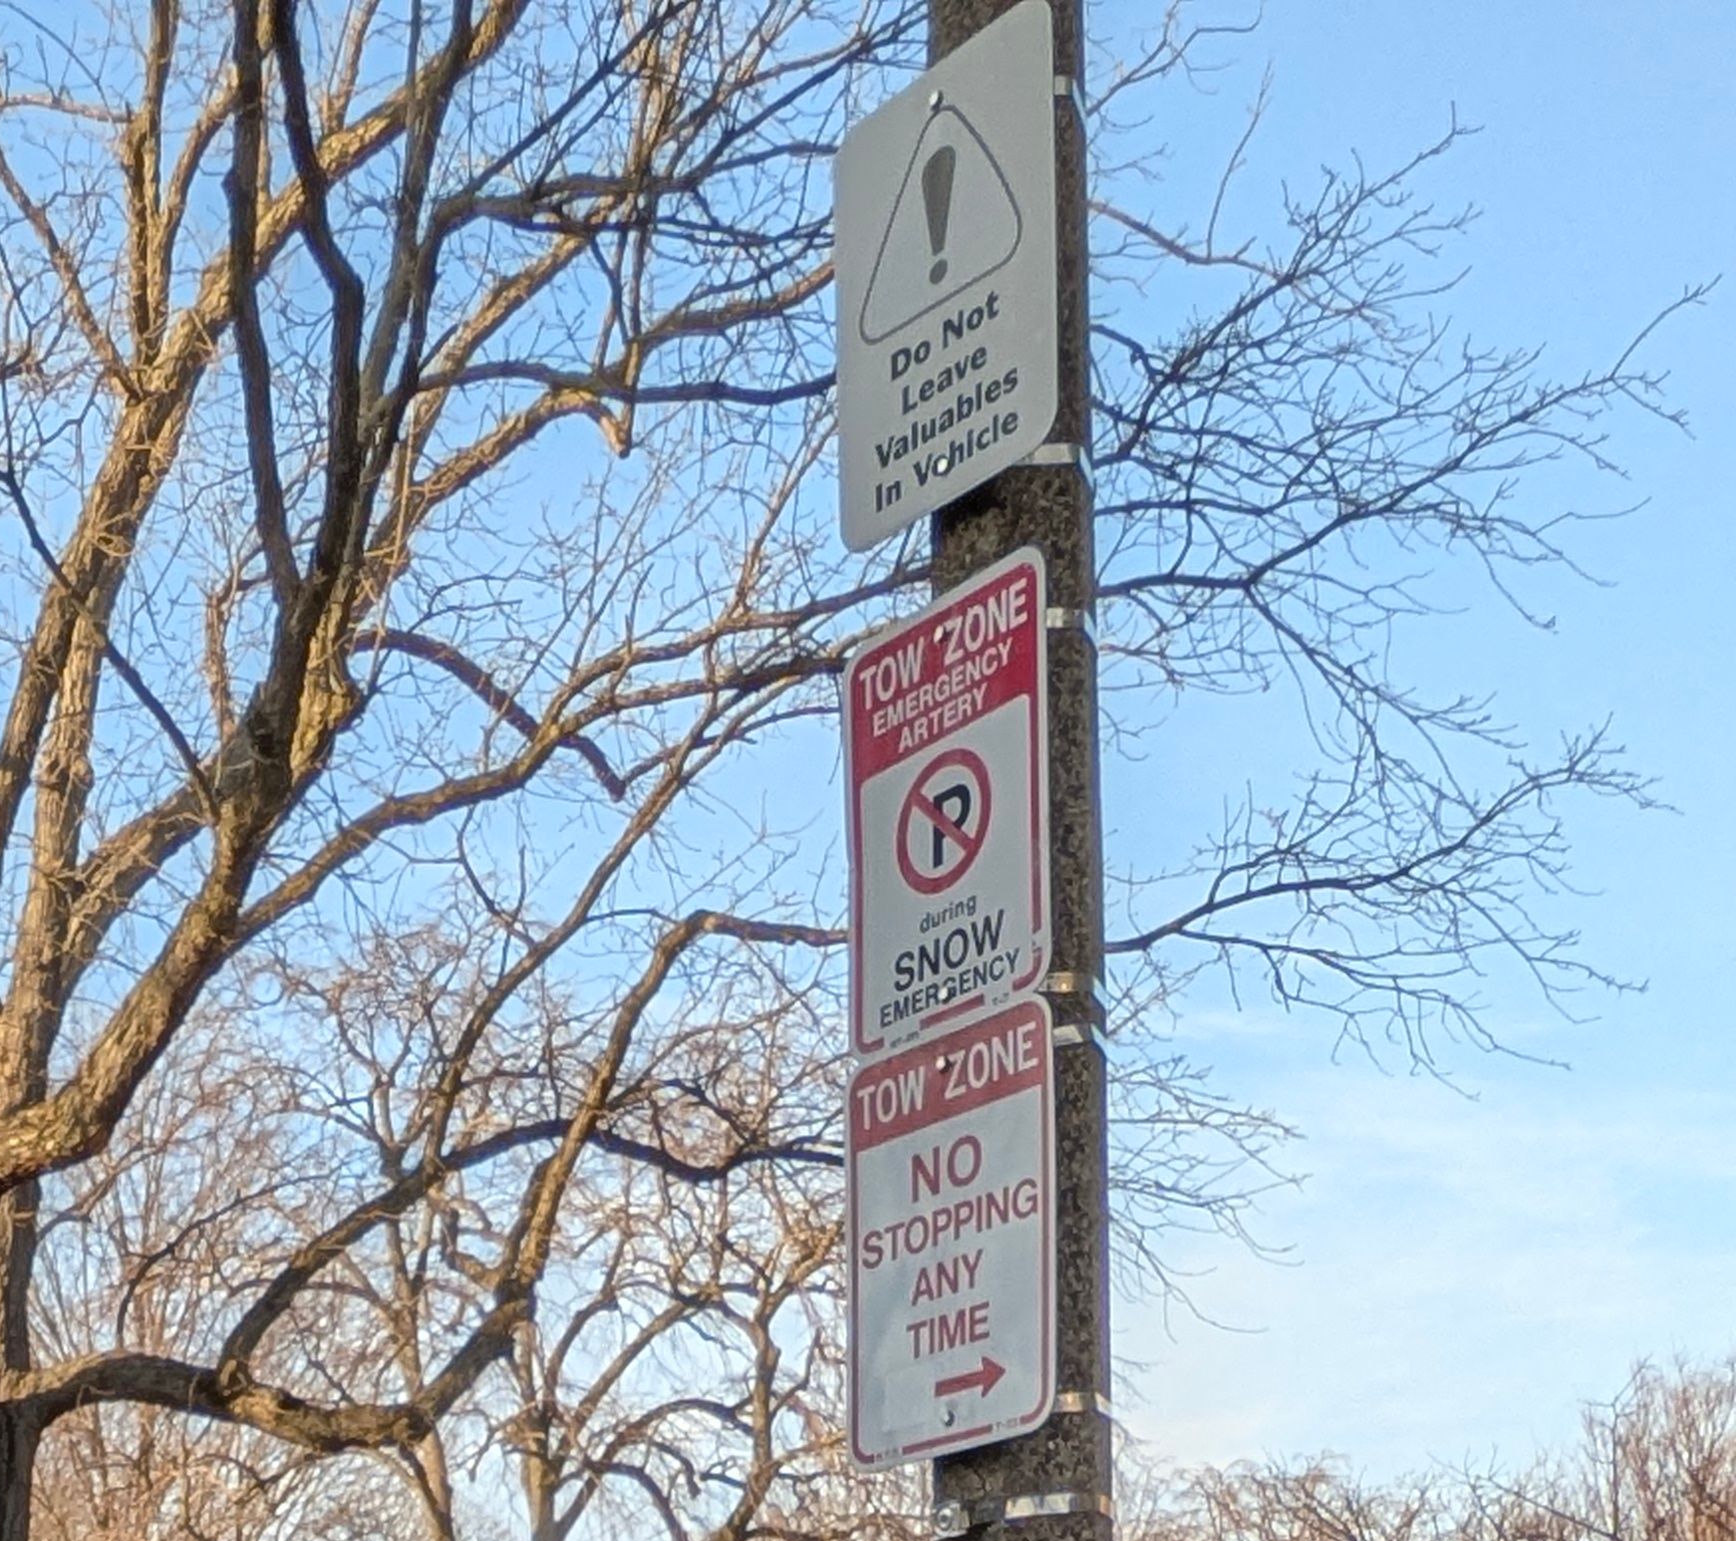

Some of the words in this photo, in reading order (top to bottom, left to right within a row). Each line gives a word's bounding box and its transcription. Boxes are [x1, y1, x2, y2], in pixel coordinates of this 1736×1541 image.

[890, 340, 931, 381] Do
[941, 291, 1000, 349] Not
[875, 367, 1018, 468] Valuables
[901, 346, 987, 415] Leave
[875, 480, 902, 512] In
[860, 636, 925, 710] TOW
[943, 577, 1028, 666] ZONE
[872, 637, 1013, 737] EMERGENCY
[898, 682, 988, 753] ARTERY
[933, 783, 971, 869] P
[894, 909, 1004, 993] SNOW
[919, 895, 977, 933] during
[857, 1066, 925, 1131] TOW
[944, 1021, 1039, 1099] ZONE
[911, 1135, 982, 1203] NO
[862, 1178, 1039, 1270] STOPPING
[911, 1249, 983, 1306] ANY
[906, 1302, 990, 1359] TIME
